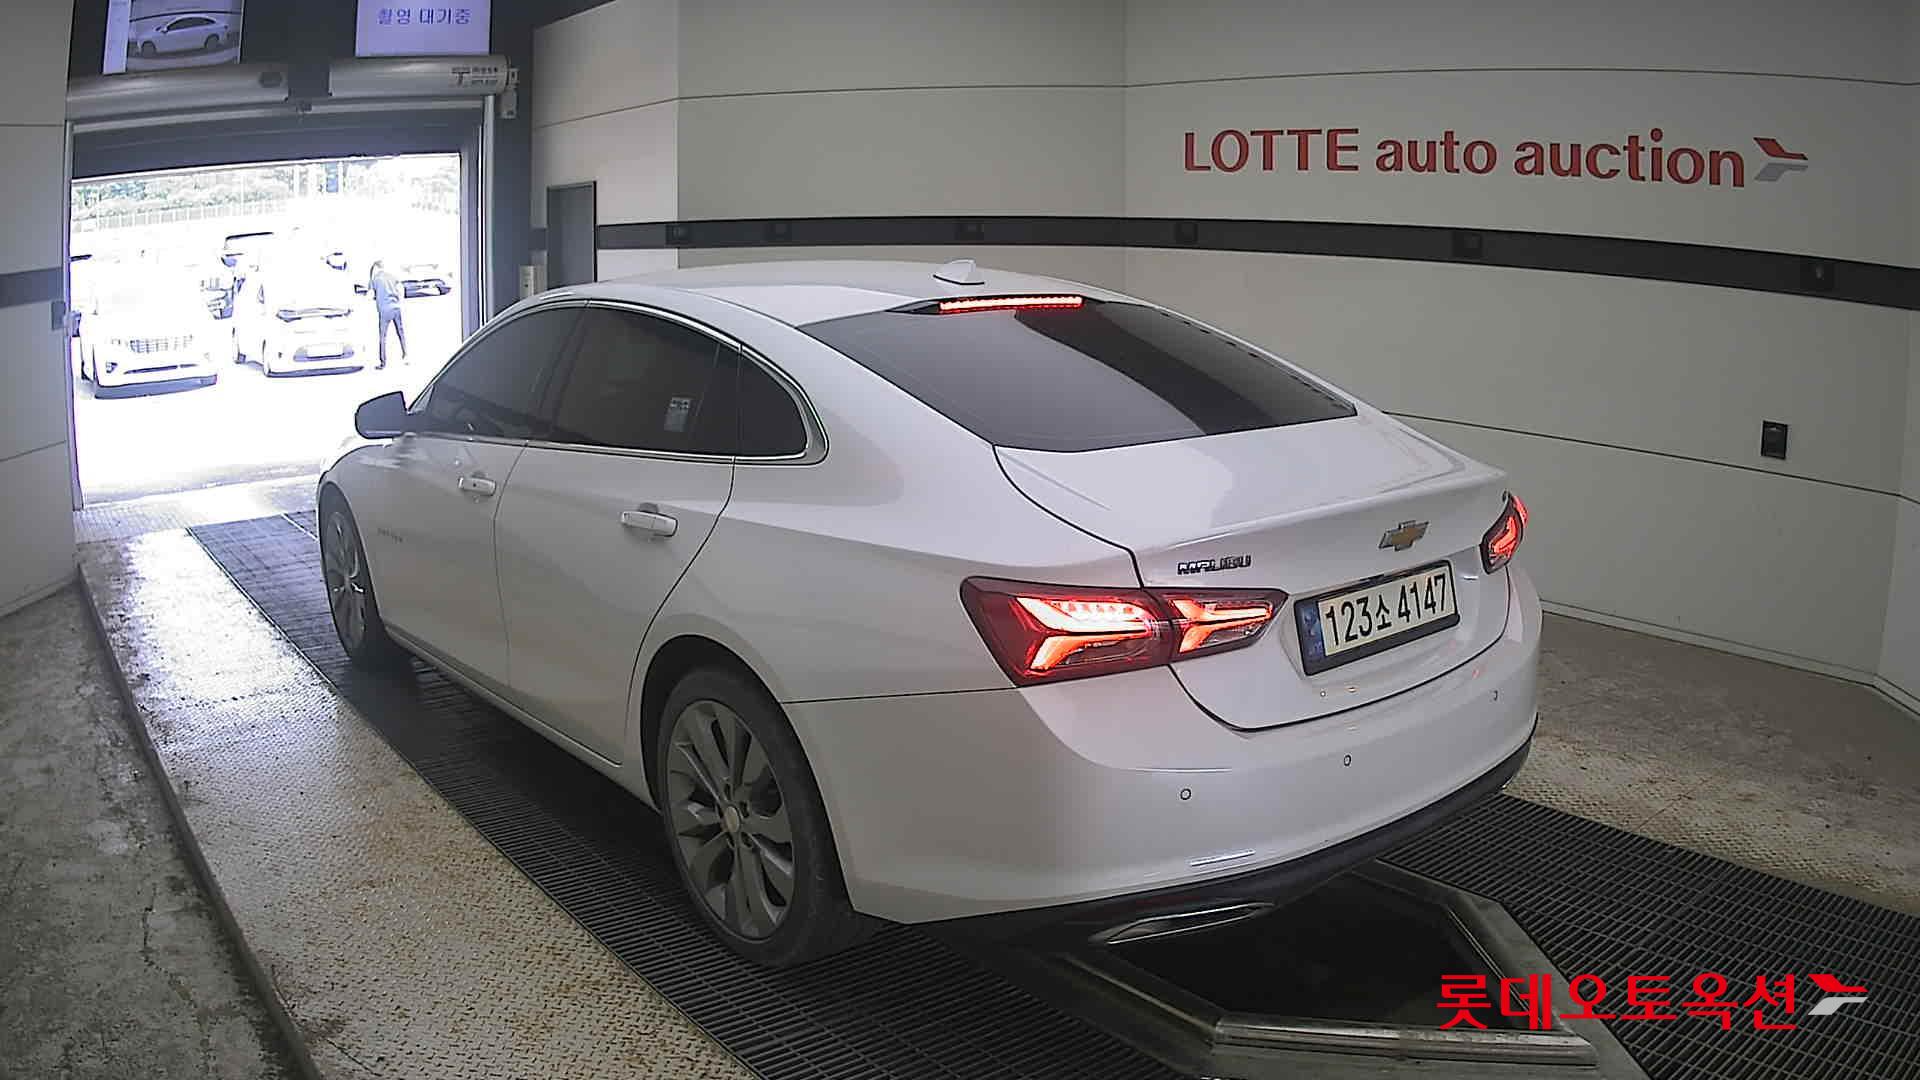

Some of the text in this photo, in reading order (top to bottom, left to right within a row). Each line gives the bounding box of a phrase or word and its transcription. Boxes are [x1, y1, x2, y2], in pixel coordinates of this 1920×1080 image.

[377, 8, 471, 25] 촬영 대기중
[1184, 127, 1745, 188] LOTTE auto auction
[1325, 572, 1446, 646] 123소 4147
